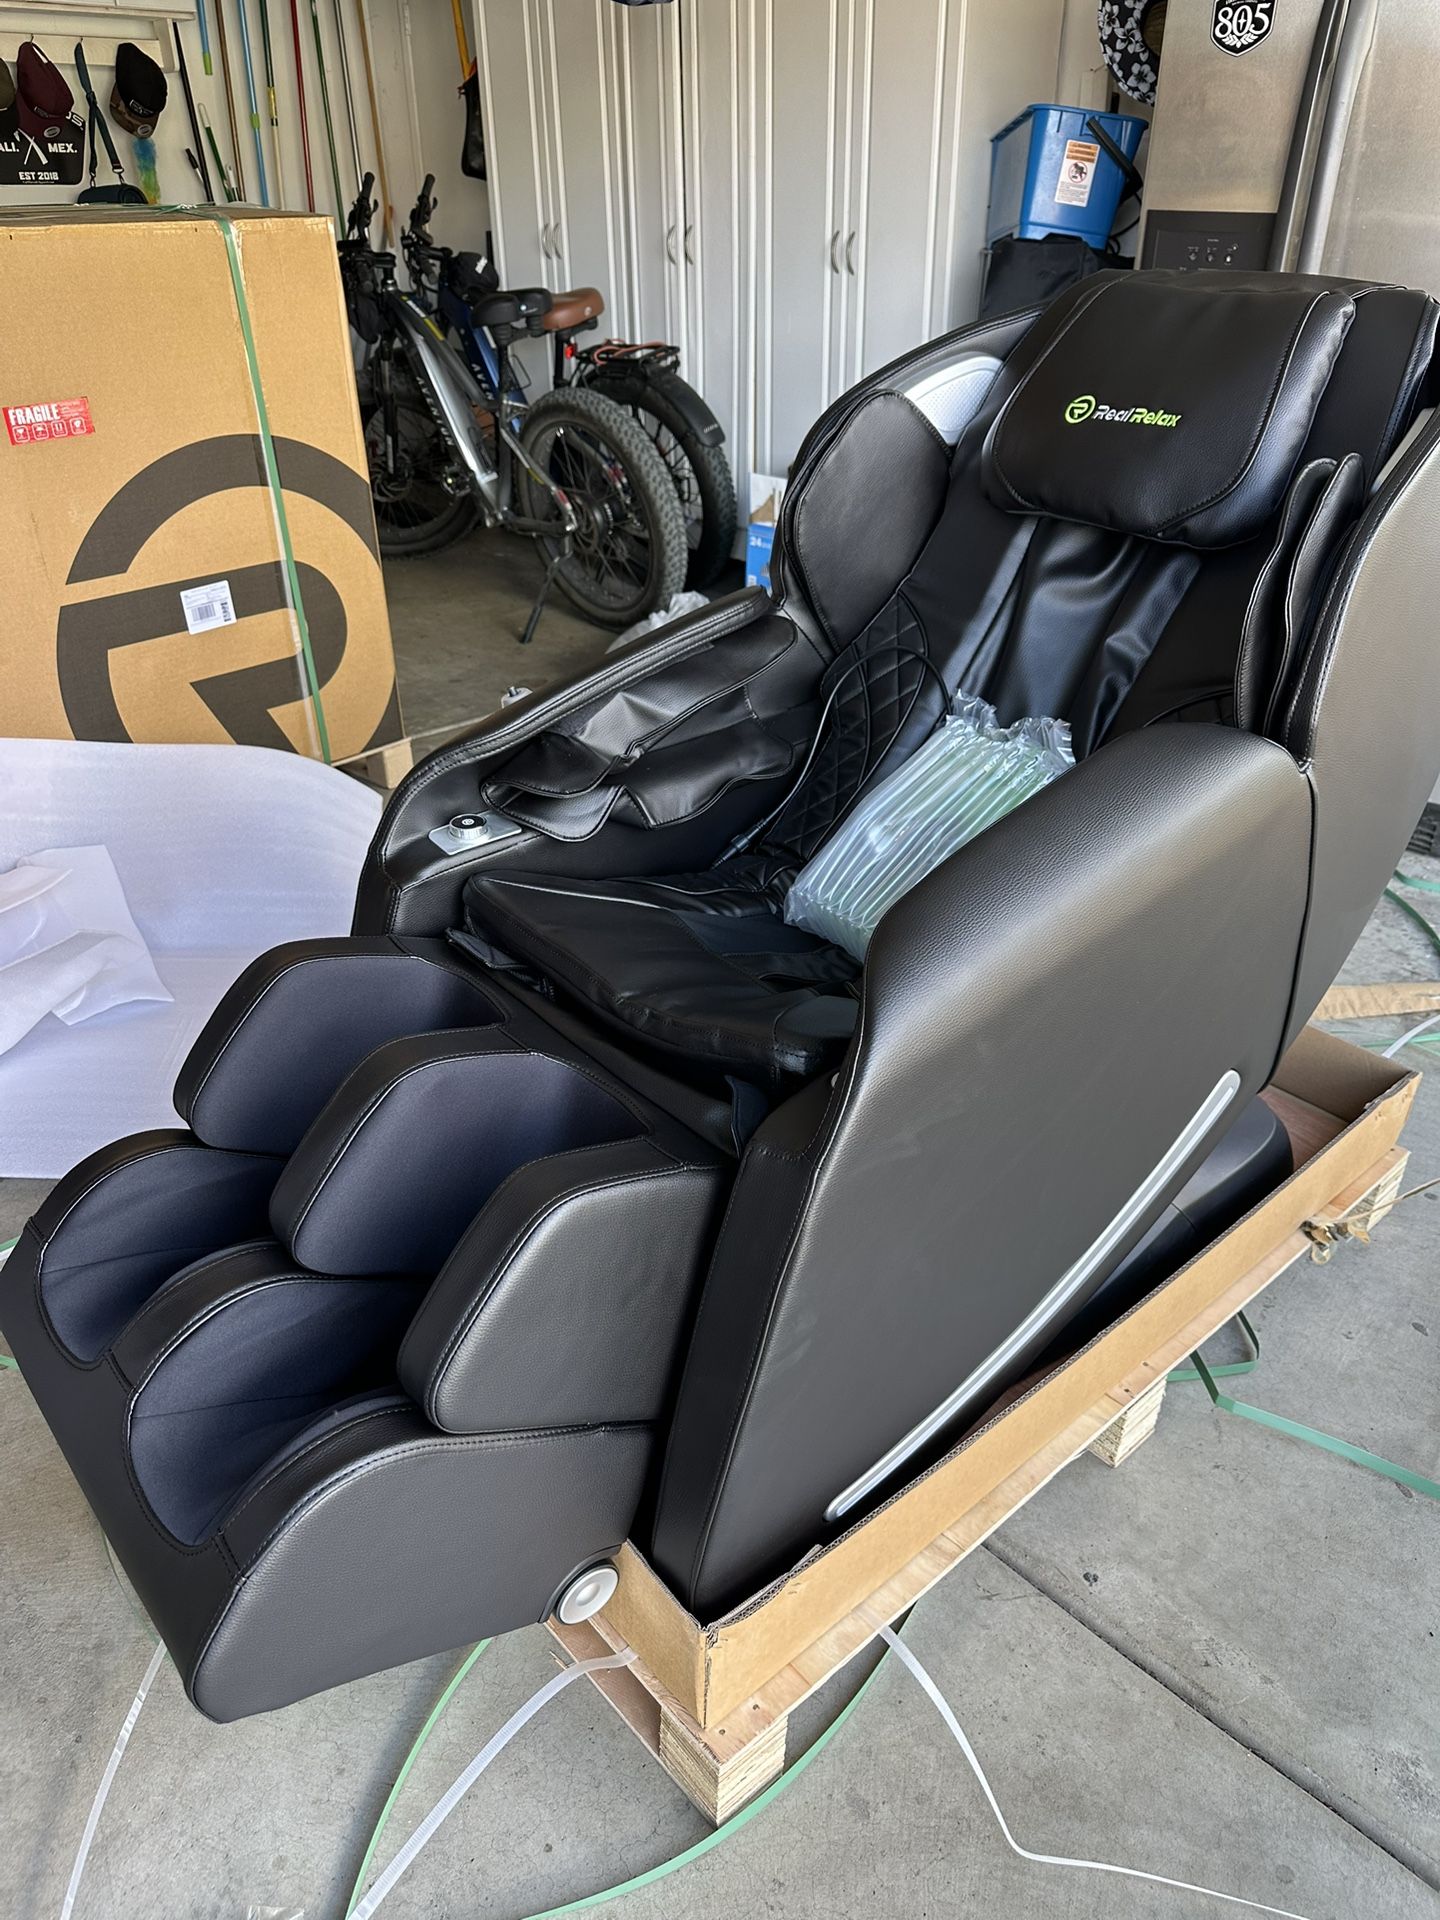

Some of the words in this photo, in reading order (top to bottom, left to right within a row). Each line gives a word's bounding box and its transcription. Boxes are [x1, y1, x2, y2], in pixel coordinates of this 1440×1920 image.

[1214, 3, 1272, 38] 805
[0, 141, 20, 152] ALI.
[47, 142, 78, 153] MEX.
[18, 171, 36, 180] EST
[37, 171, 59, 180] 2018
[8, 403, 61, 427] FRAGILE
[416, 376, 455, 446] AVENTON
